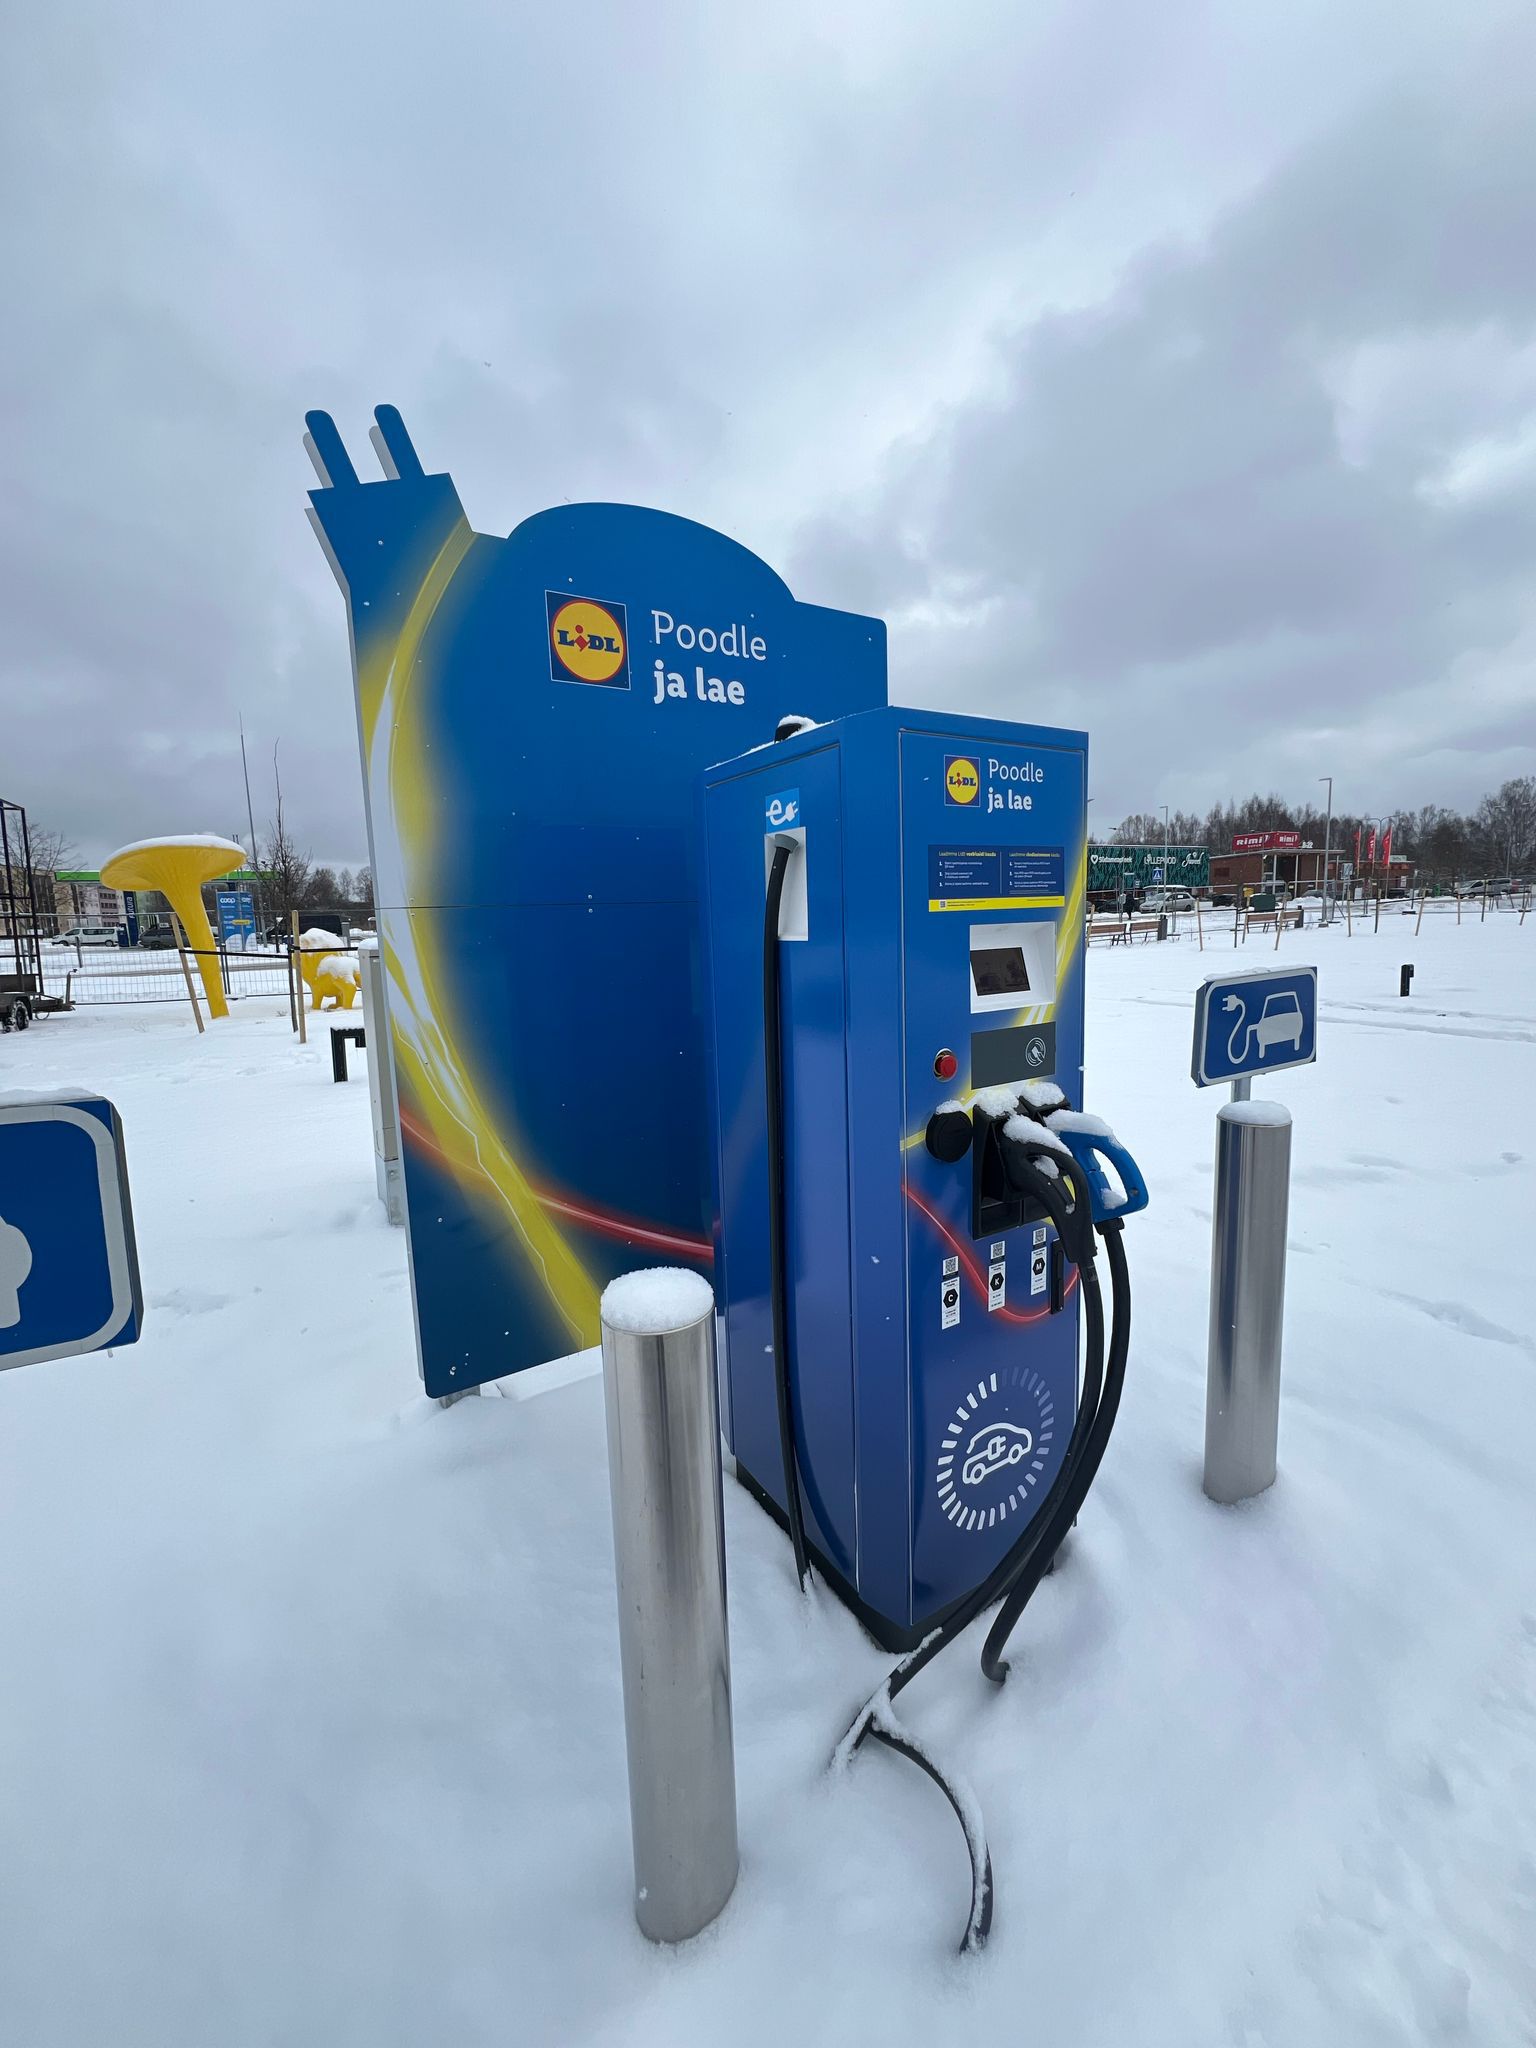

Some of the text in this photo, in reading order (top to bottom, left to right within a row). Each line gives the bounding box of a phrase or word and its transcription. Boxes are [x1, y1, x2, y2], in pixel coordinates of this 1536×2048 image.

[651, 609, 767, 661] Poodle
[653, 659, 745, 705] ja lae
[988, 758, 1044, 783] Poodle
[987, 786, 1033, 813] ja lae
[995, 1276, 1000, 1286] K
[948, 1294, 953, 1303] C
